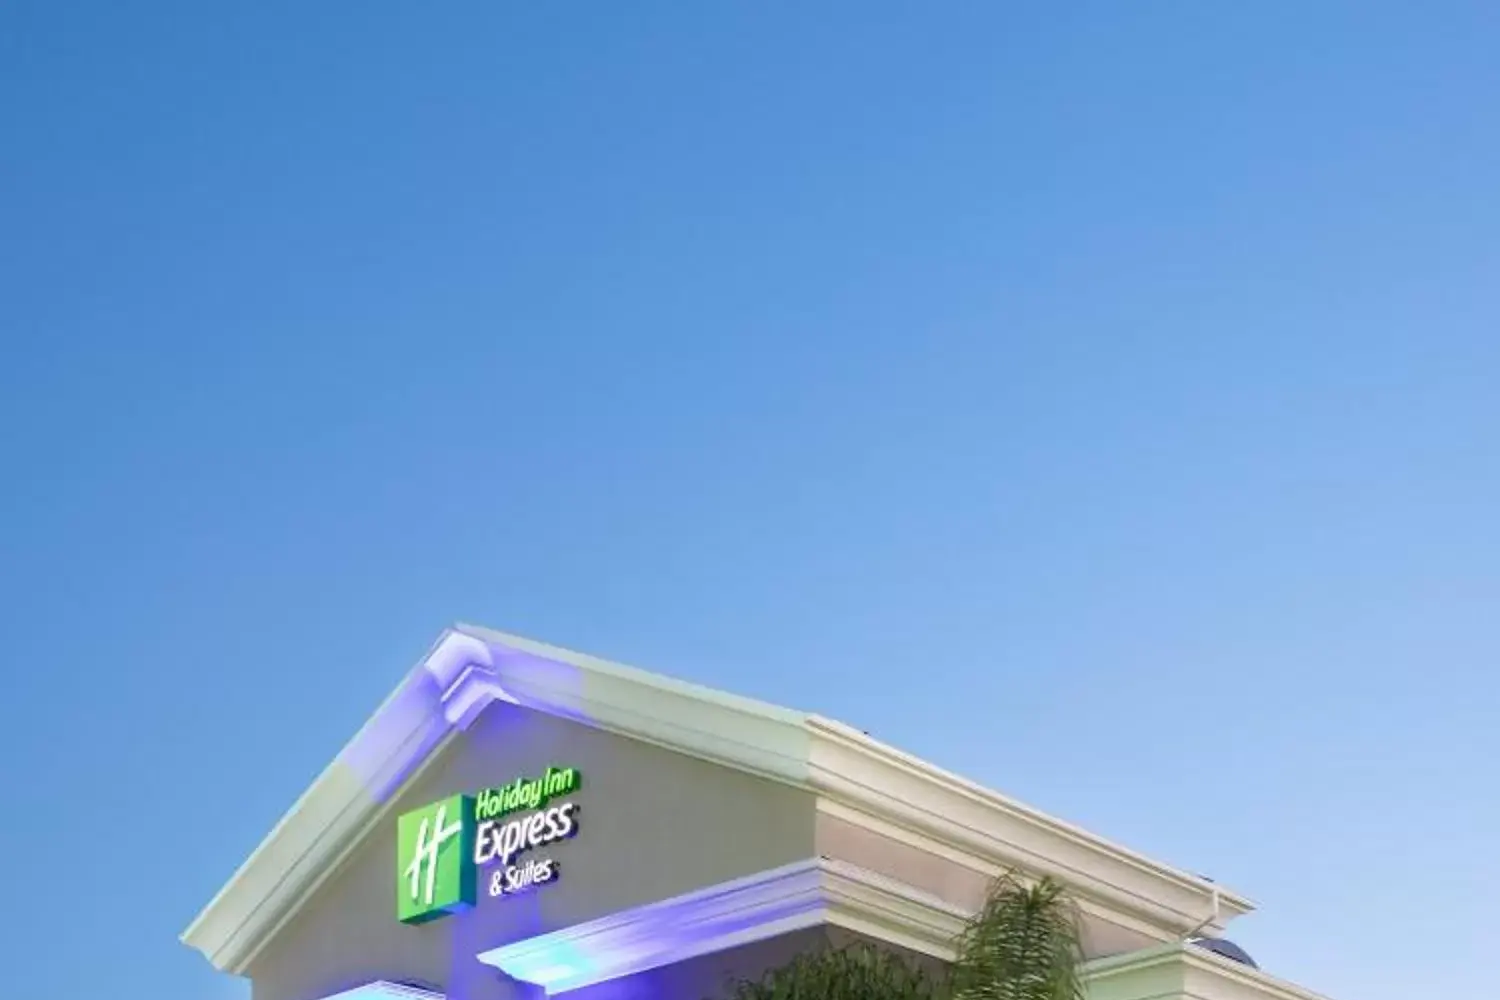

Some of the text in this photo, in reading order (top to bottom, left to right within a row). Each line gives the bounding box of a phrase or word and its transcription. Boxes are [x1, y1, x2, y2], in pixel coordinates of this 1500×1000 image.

[475, 767, 573, 821] Holiday Inn
[403, 804, 463, 905] H
[474, 802, 574, 864] Express
[489, 859, 553, 896] & Suites
